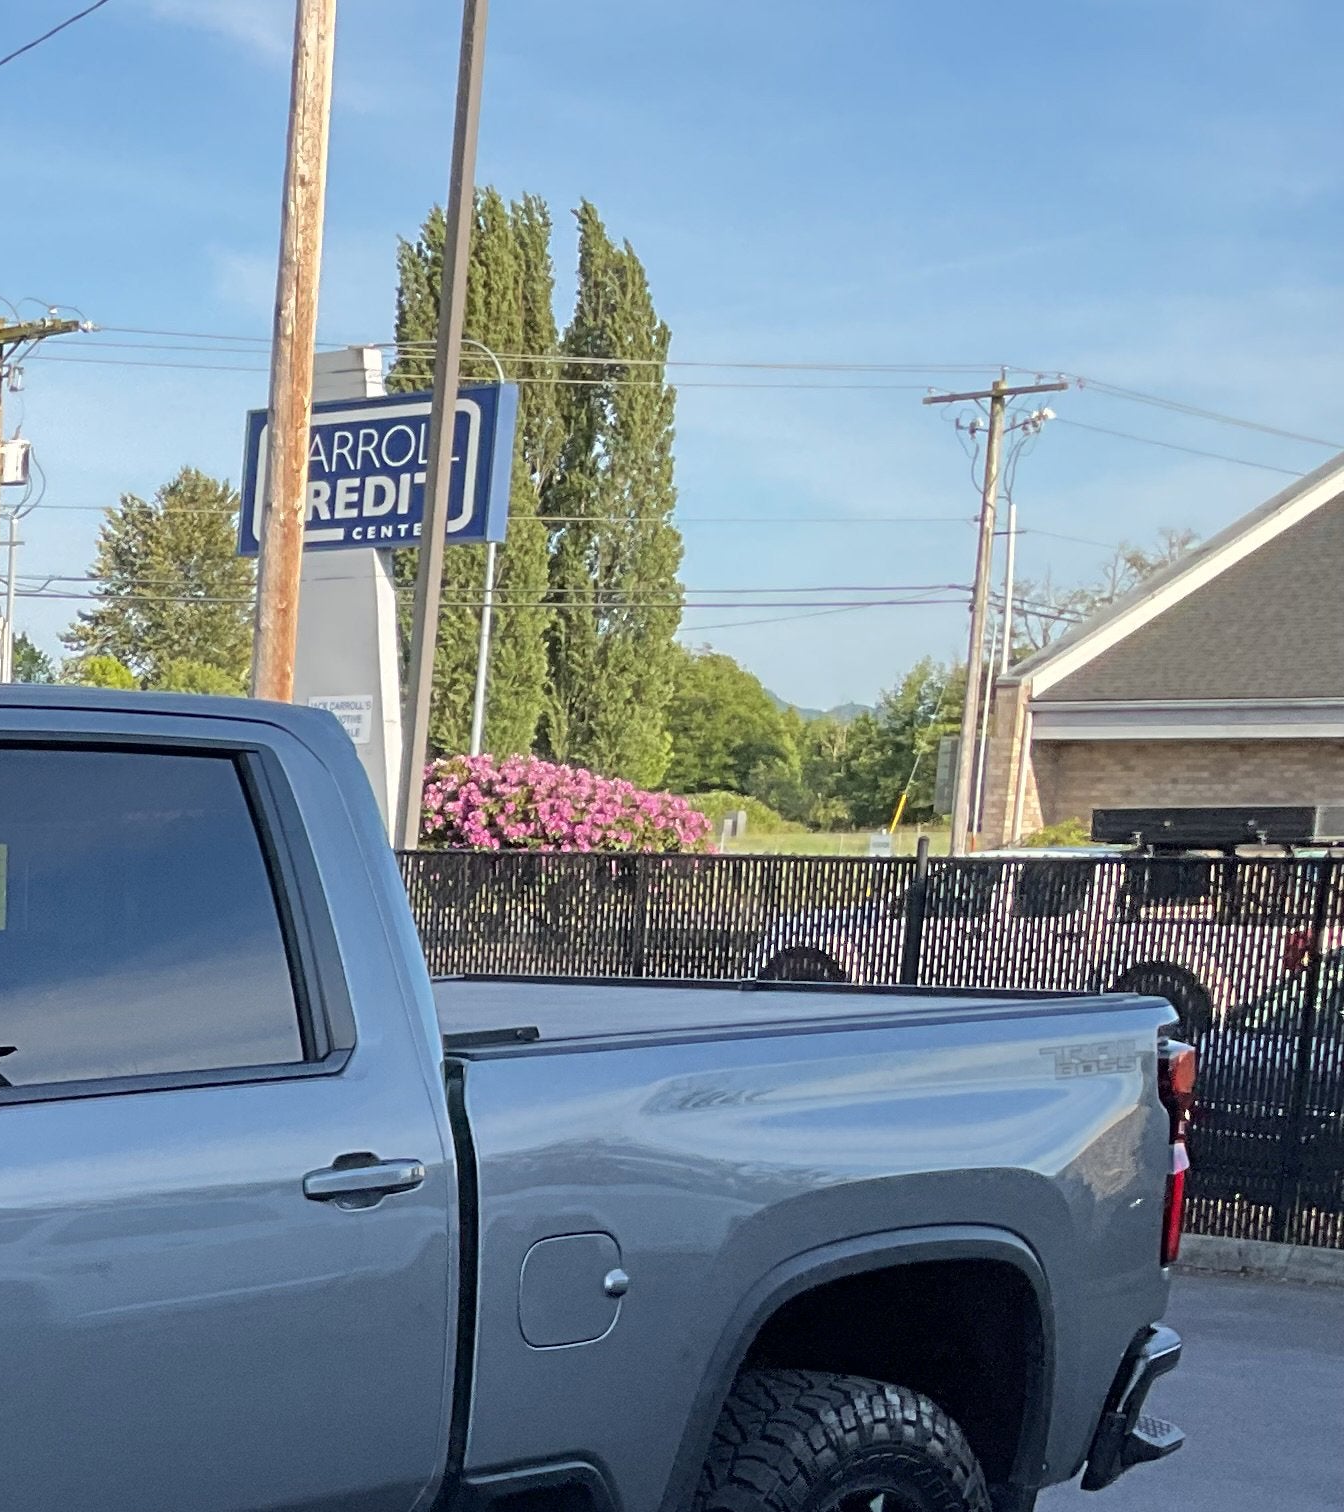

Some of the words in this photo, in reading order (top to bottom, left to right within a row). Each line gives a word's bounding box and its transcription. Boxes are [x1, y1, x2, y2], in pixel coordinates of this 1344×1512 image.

[308, 422, 460, 473] ARROL
[306, 471, 427, 522] REDI
[351, 521, 424, 541] CENTE
[1055, 1056, 1138, 1080] BOSS
